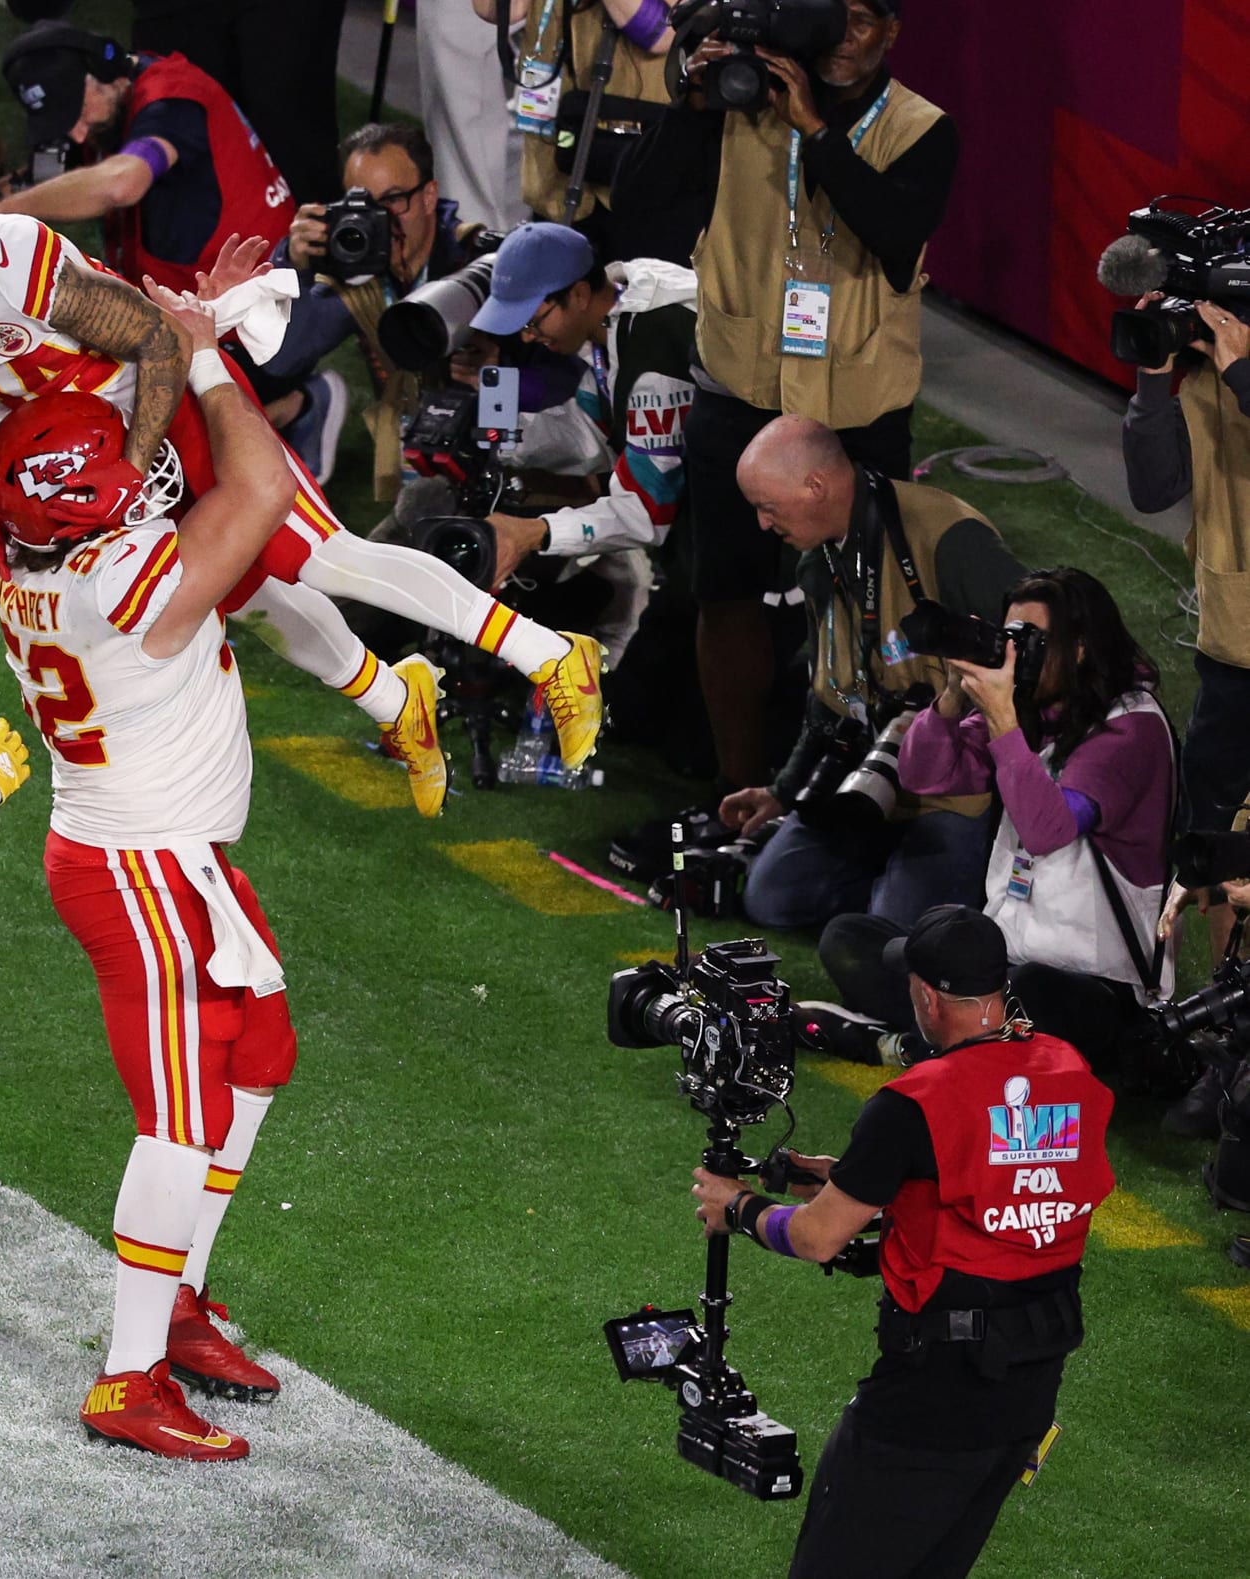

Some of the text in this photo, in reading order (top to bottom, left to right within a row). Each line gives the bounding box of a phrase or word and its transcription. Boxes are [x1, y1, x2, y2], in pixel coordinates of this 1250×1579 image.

[865, 565, 876, 610] SONY
[1, 618, 111, 768] 2
[988, 1103, 1081, 1152] LVII
[1041, 1150, 1070, 1159] BOWL
[1012, 1166, 1064, 1195] FOX
[85, 1381, 129, 1415] NIKE
